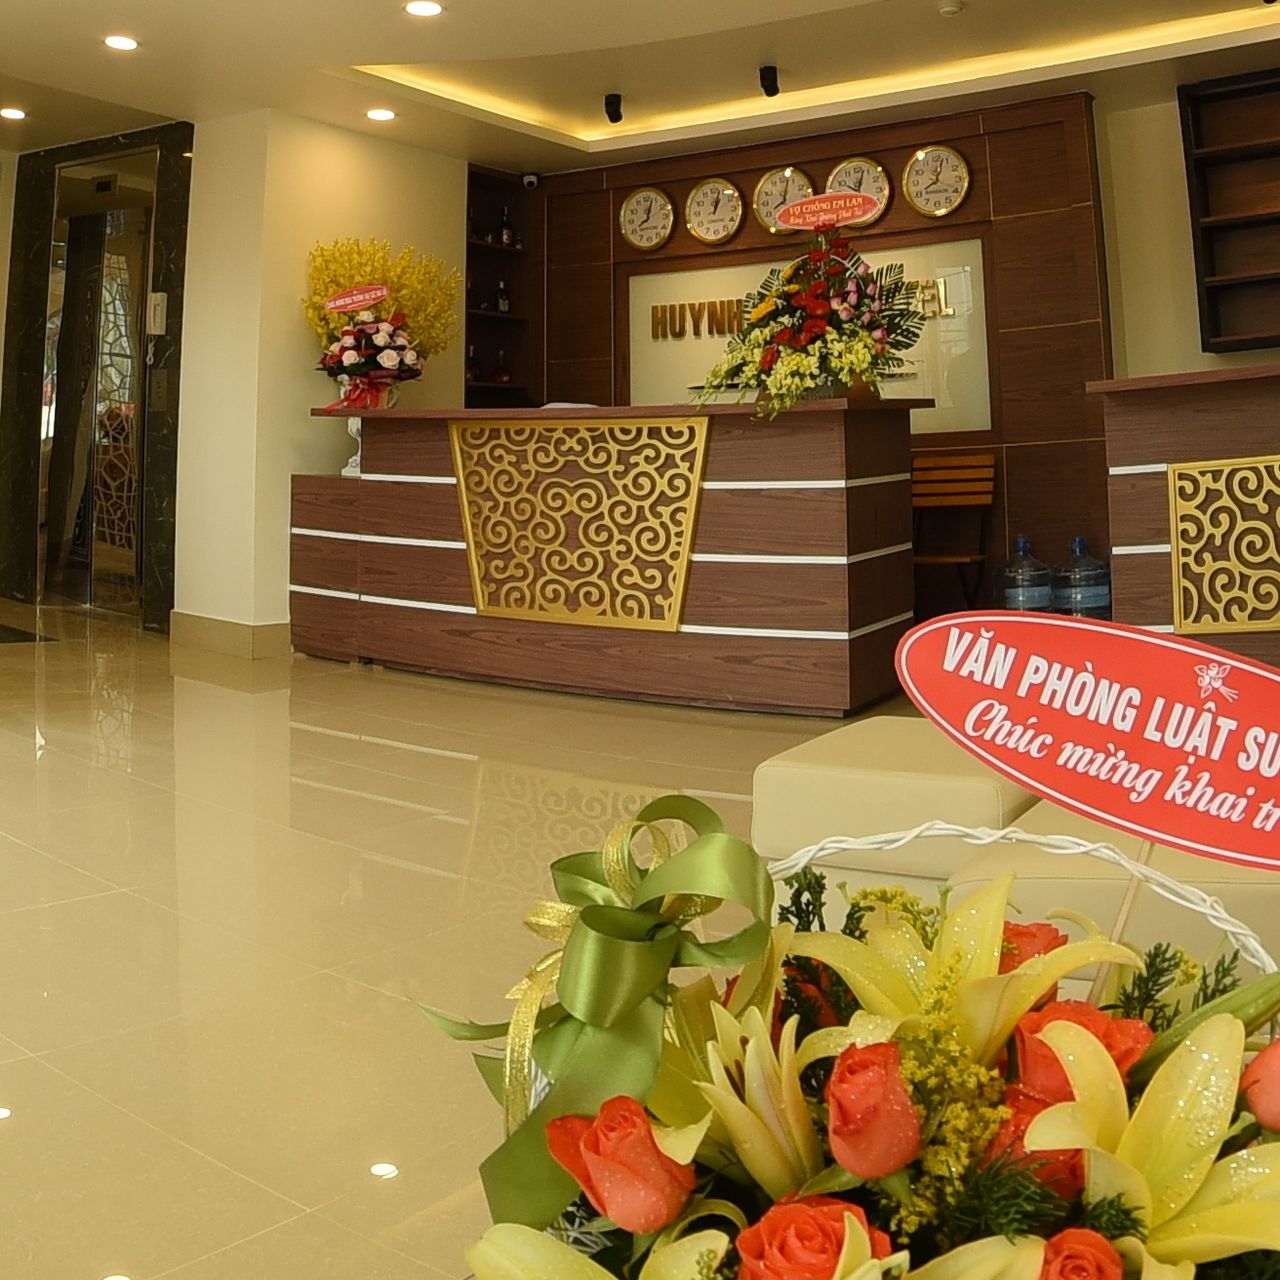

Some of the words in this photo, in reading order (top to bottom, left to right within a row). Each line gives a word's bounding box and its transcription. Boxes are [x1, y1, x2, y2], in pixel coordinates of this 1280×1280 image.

[942, 626, 1018, 691] VĂN
[1015, 654, 1142, 733] PHÒNG
[1142, 696, 1239, 764] LUẬT
[963, 698, 1054, 758] Chúc
[1056, 741, 1163, 803] mừng
[1163, 764, 1257, 823] khai
